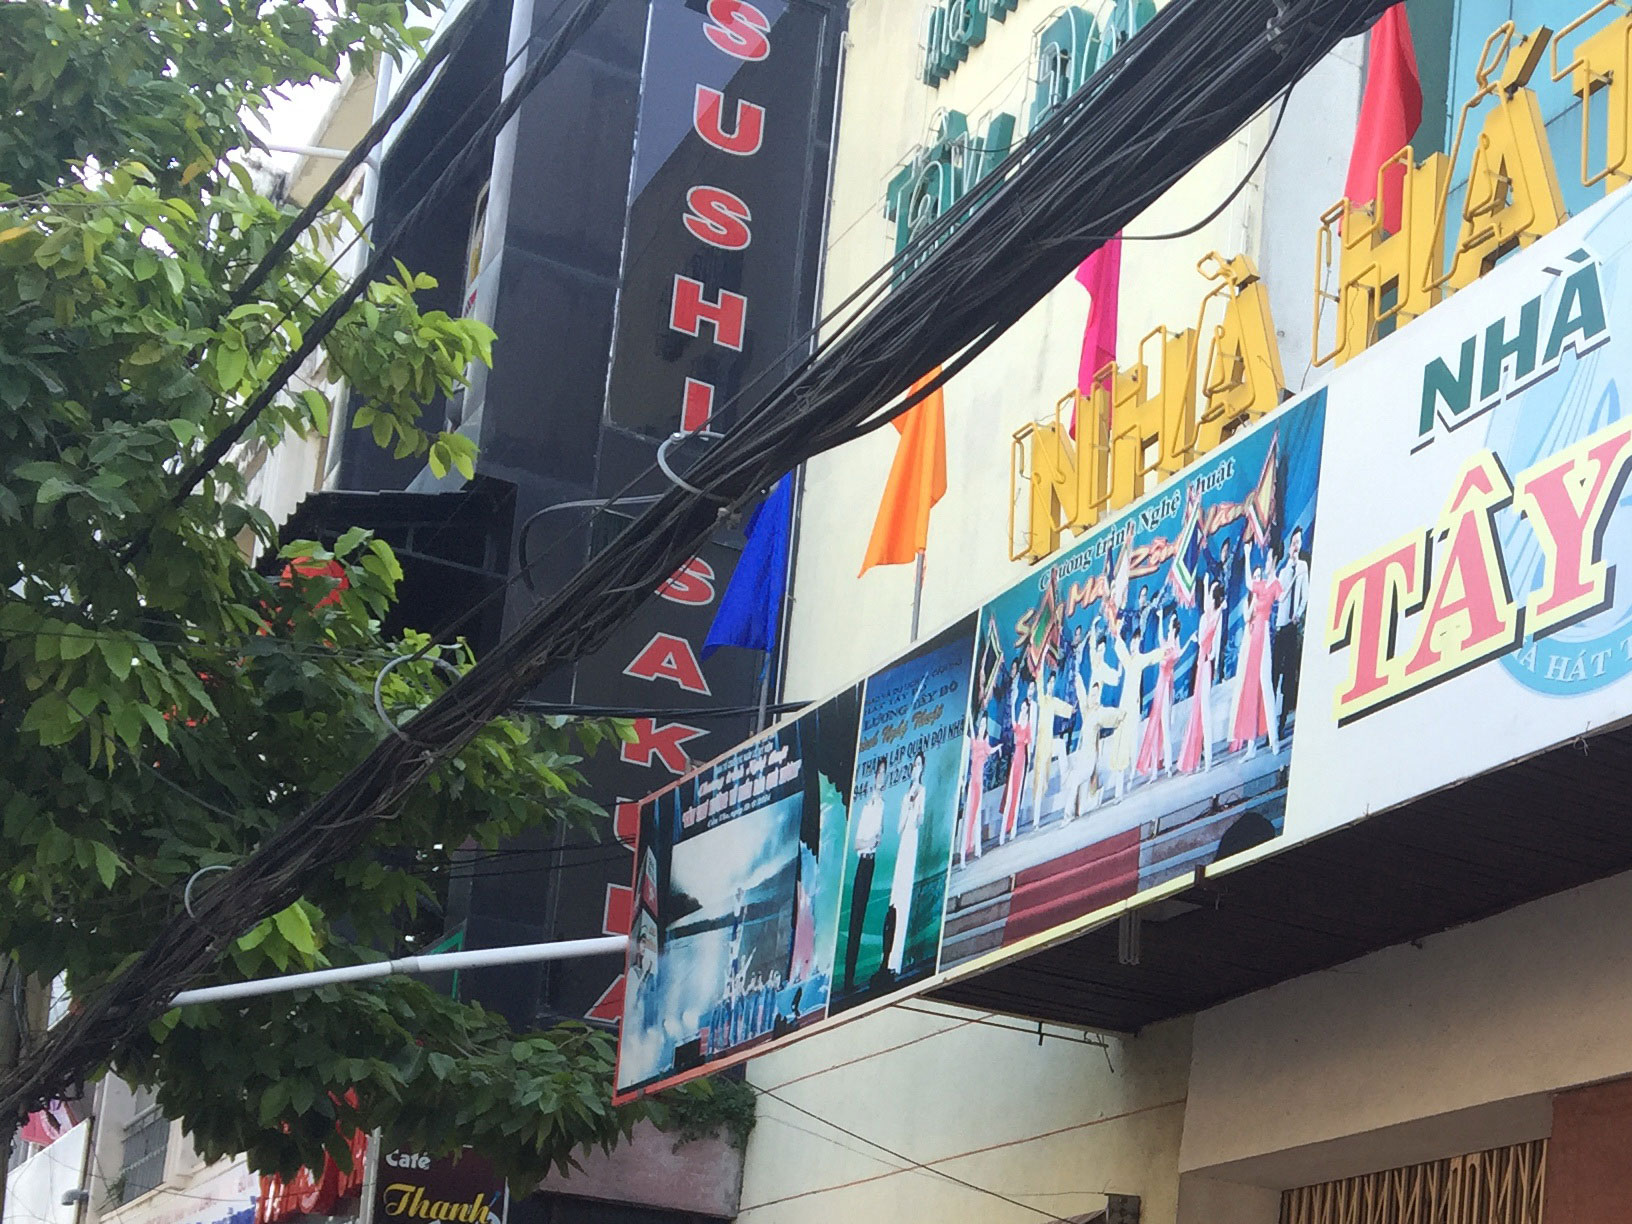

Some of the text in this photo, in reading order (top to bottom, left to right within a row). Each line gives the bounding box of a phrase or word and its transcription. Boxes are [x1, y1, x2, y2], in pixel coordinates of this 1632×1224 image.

[668, 0, 772, 437] SUSHI
[1410, 248, 1611, 455] NHÀ
[1010, 250, 1289, 560] NHÀ
[1139, 488, 1182, 530] Nghệ
[1544, 648, 1612, 683] HÁT
[385, 1149, 431, 1170] Café
[383, 1183, 490, 1224] Thanh
